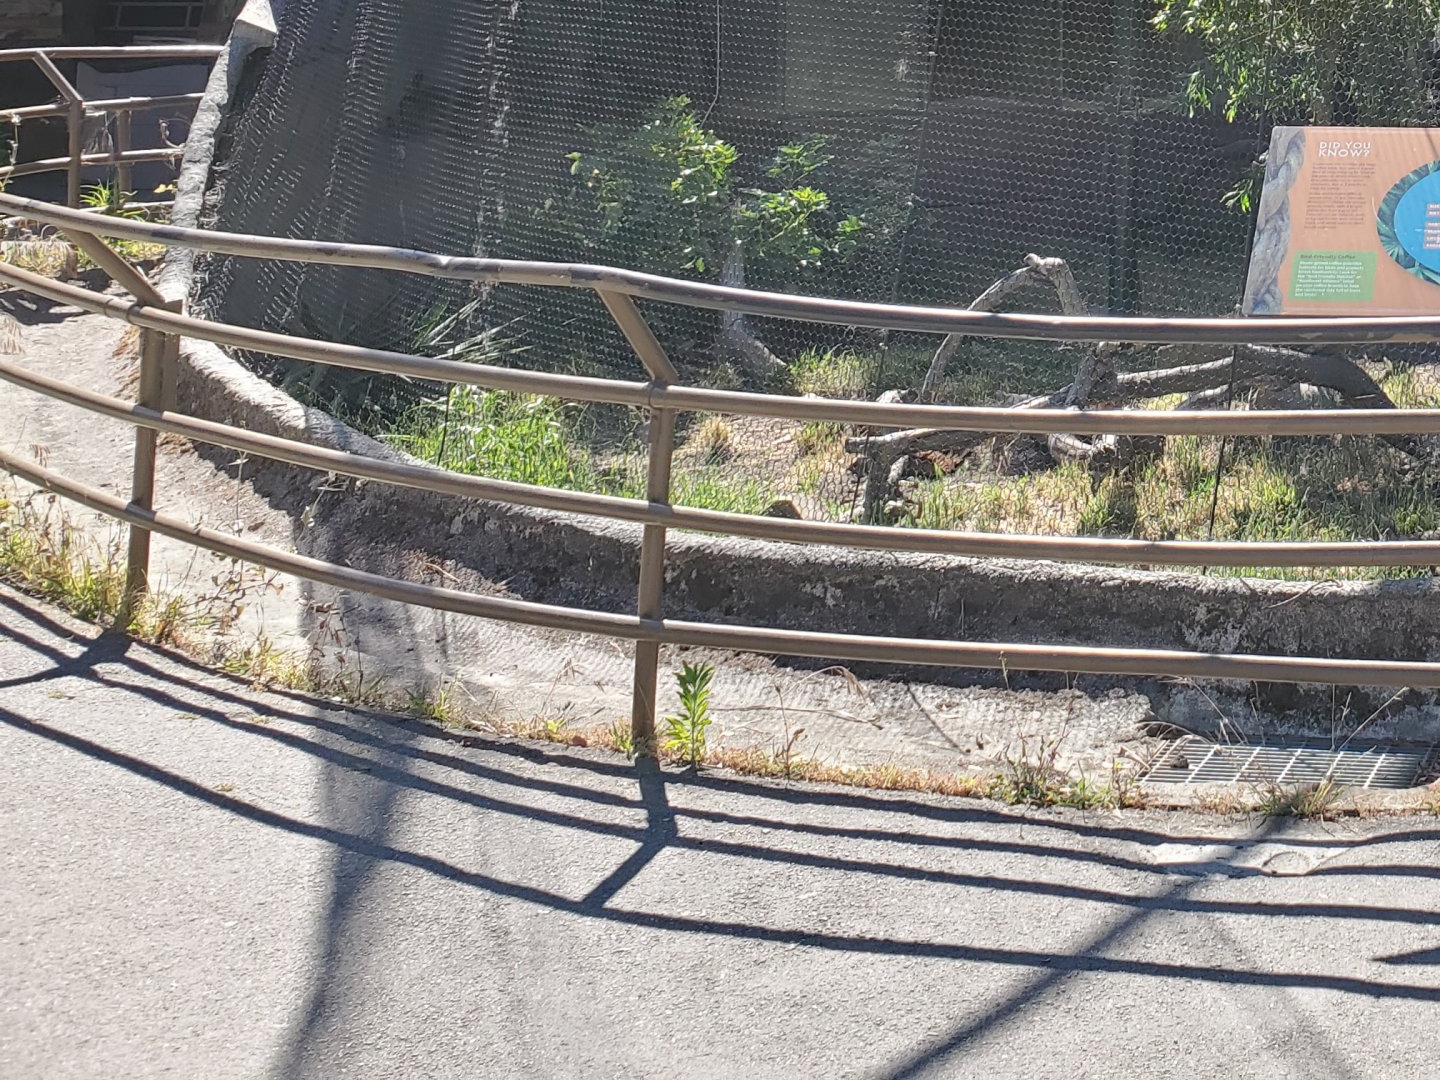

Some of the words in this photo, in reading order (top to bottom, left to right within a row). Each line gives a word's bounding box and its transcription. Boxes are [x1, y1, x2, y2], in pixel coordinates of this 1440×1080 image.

[1319, 141, 1341, 149] DID
[1345, 141, 1371, 149] YOU
[1318, 149, 1370, 157] KNOW?
